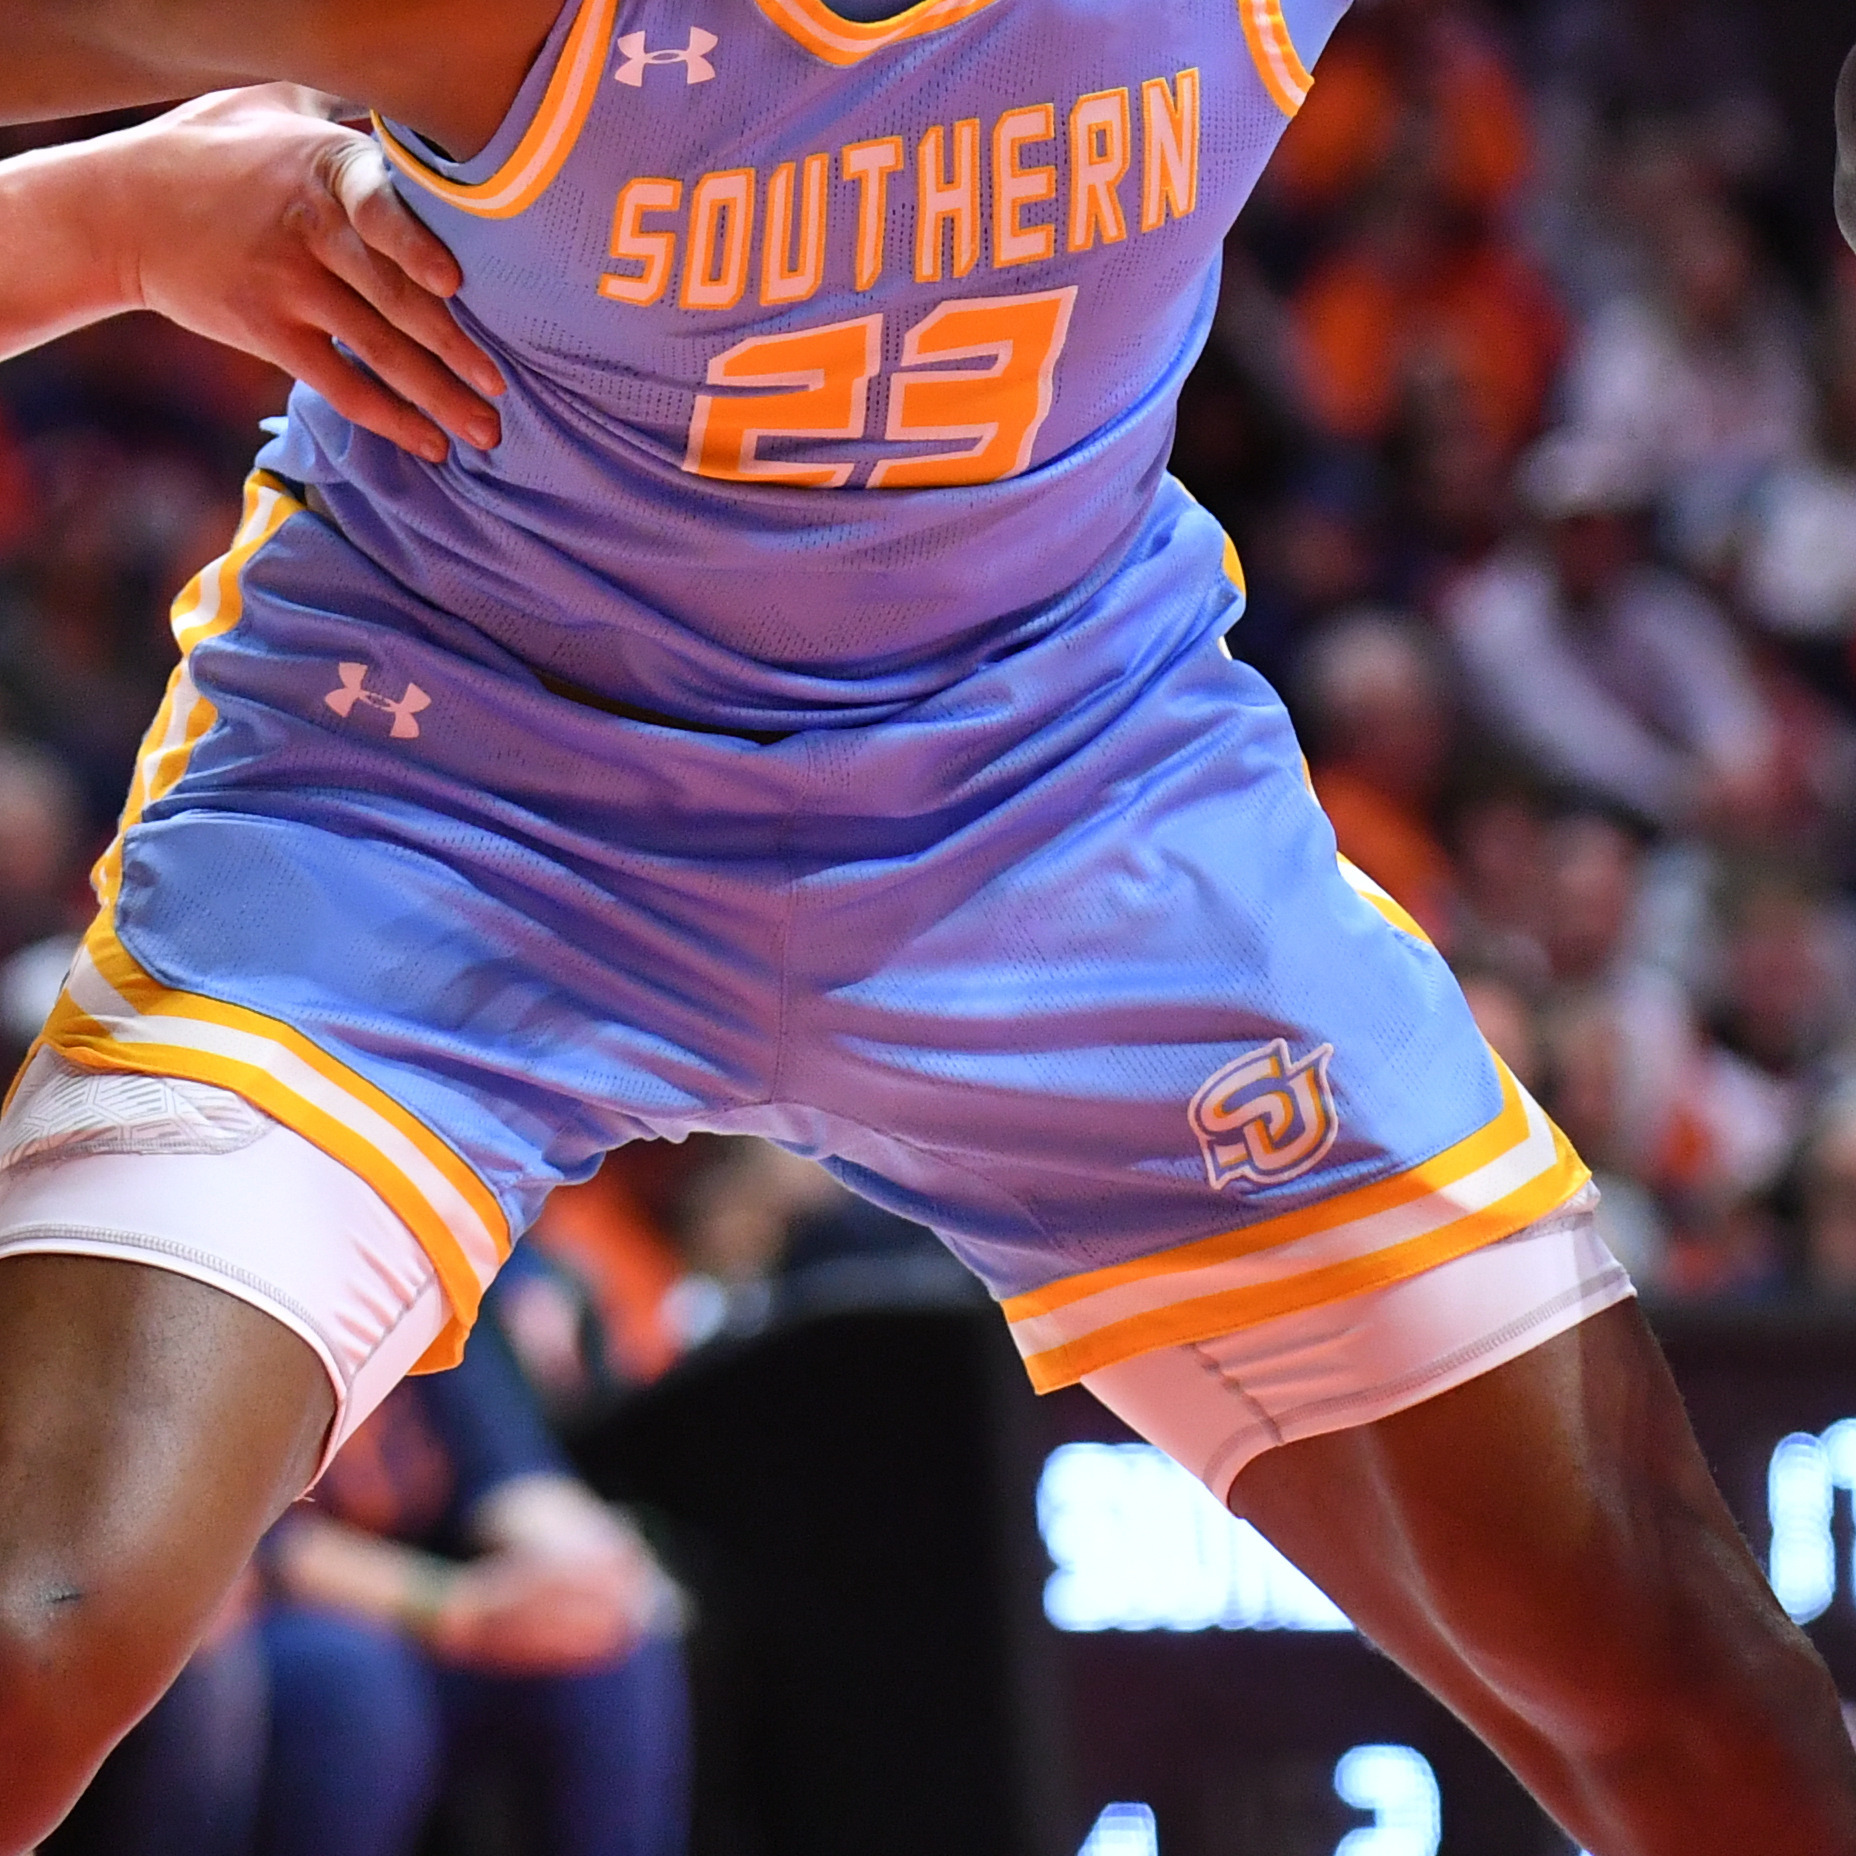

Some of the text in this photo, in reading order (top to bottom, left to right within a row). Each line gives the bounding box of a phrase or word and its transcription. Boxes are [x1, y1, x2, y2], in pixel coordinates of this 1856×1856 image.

[598, 67, 1200, 312] SOUTHERN
[681, 285, 1078, 489] 23
[1187, 1037, 1338, 1191] SU
